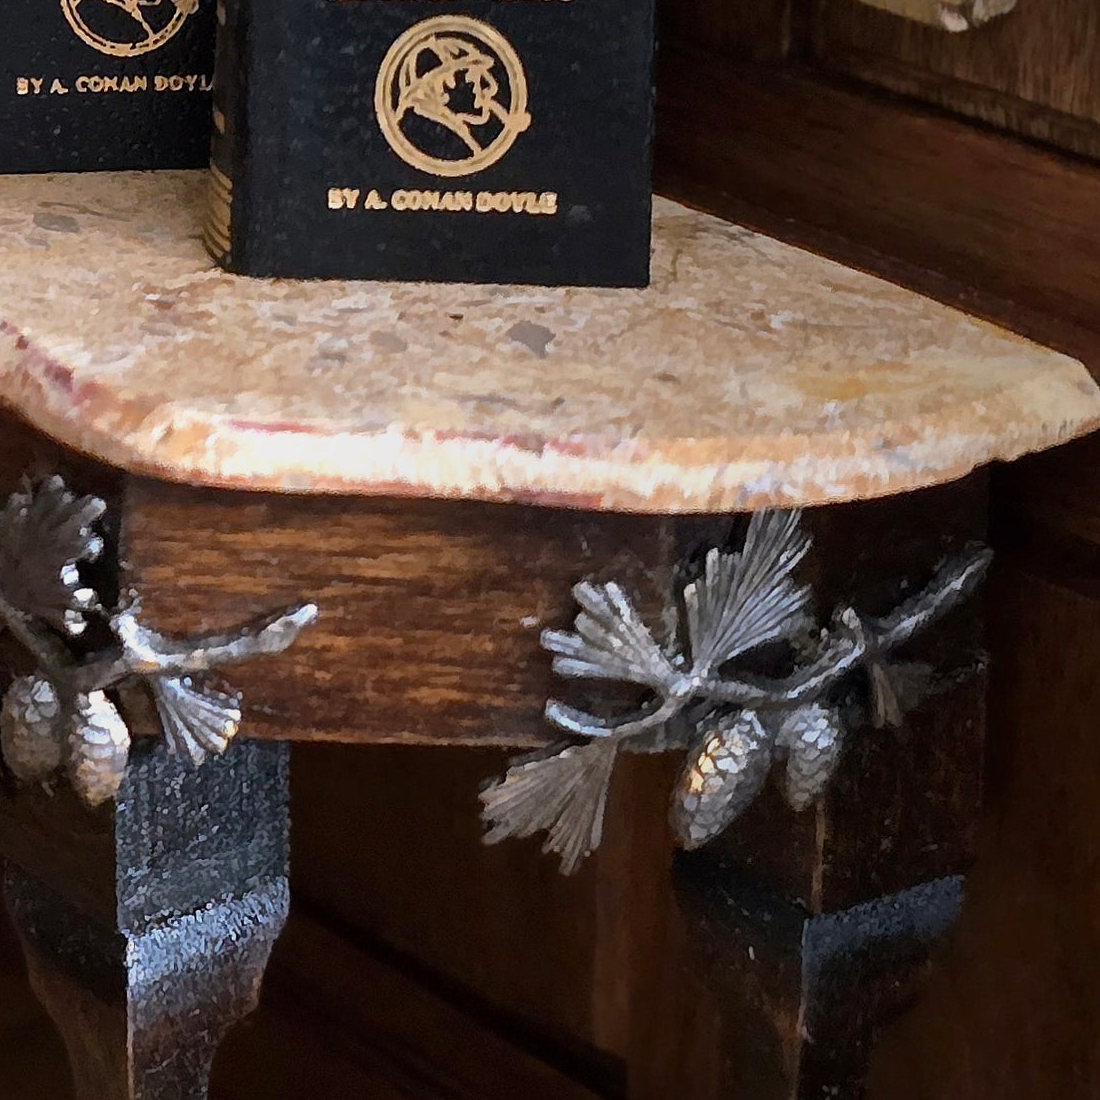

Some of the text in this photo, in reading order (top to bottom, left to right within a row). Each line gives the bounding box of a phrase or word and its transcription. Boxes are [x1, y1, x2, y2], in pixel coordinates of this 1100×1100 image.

[15, 76, 44, 95] BY
[74, 74, 149, 93] CONAN
[327, 187, 361, 210] BY
[390, 188, 474, 213] CONAN
[475, 190, 559, 215] DOYLE
